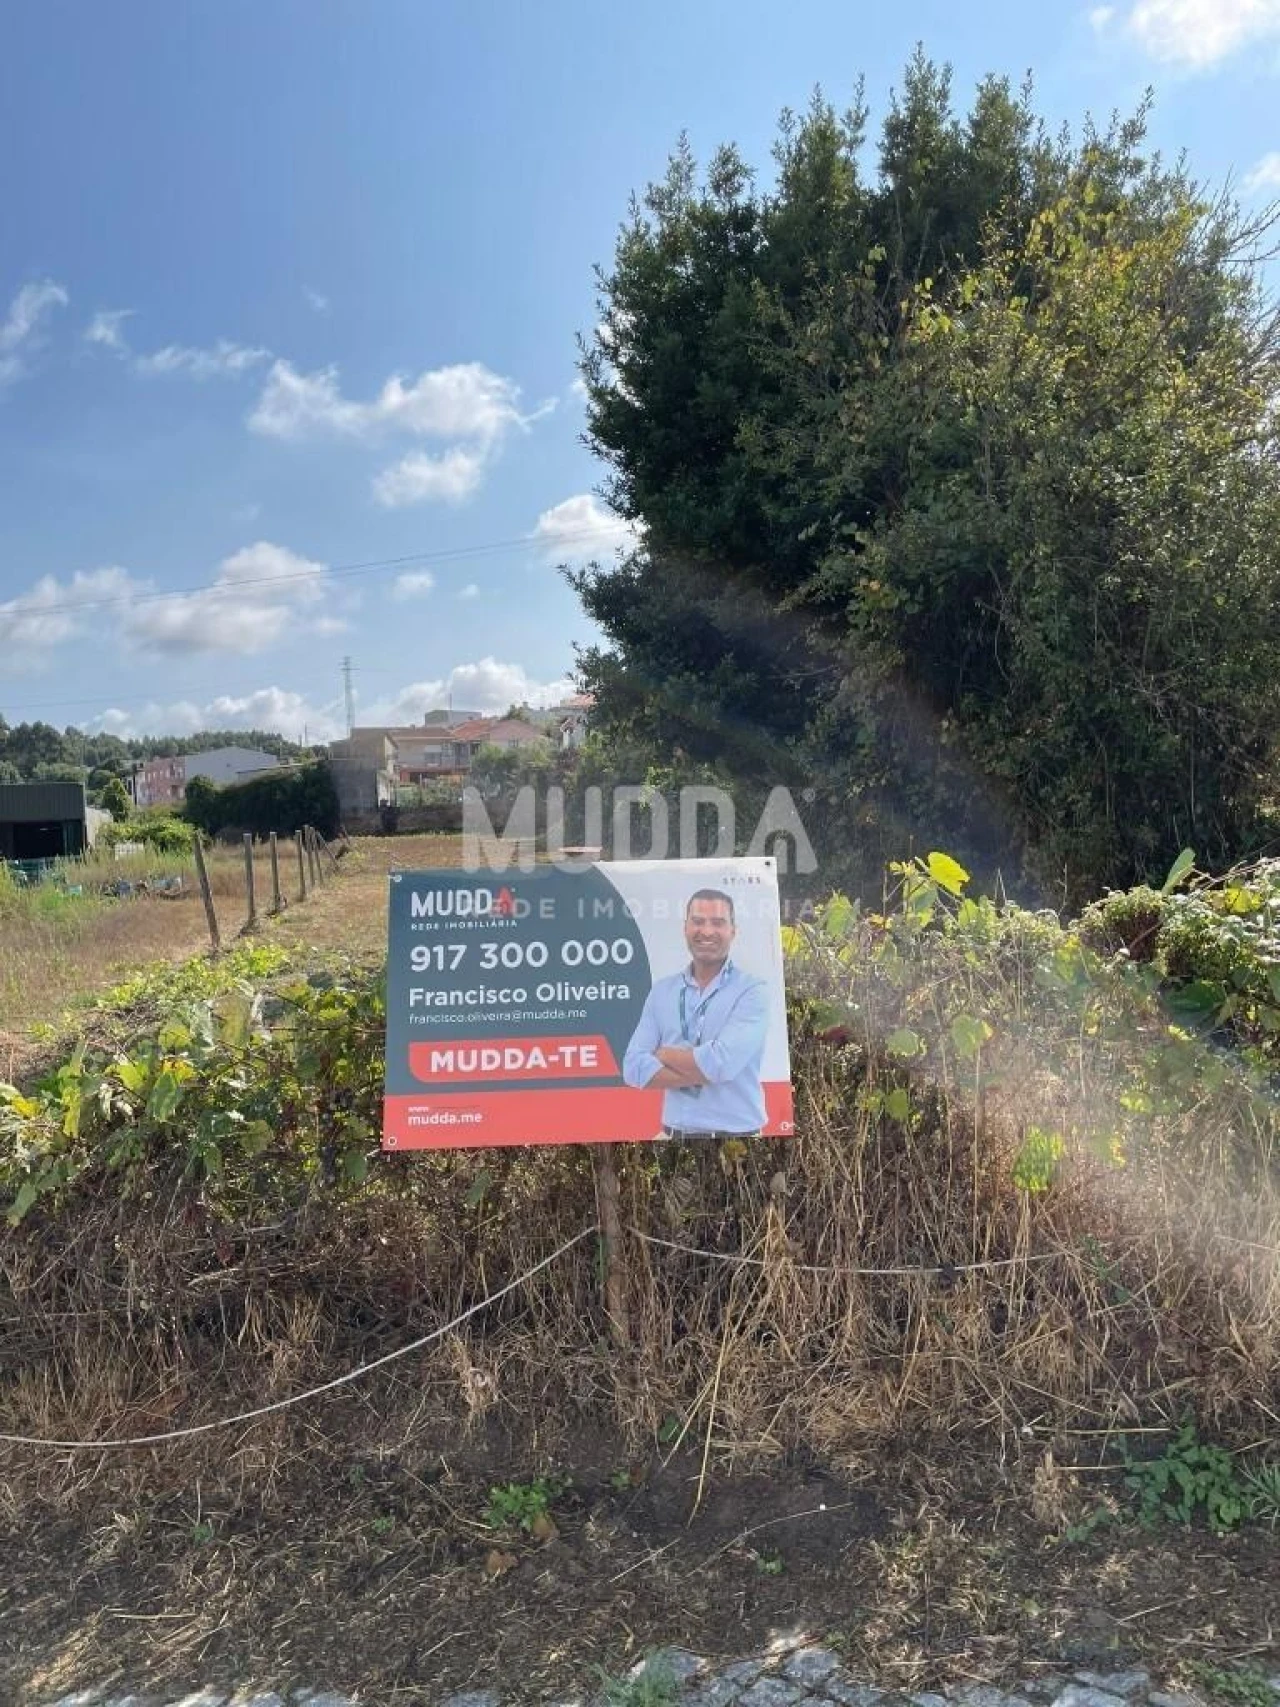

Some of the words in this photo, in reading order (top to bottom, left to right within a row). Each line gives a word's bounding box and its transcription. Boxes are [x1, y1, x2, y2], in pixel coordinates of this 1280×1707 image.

[411, 887, 514, 917] MUDDA
[411, 922, 439, 931] REDE
[410, 944, 467, 971] 917
[479, 941, 548, 969] 300
[560, 938, 633, 966] 000
[409, 986, 527, 1007] Francisco
[536, 981, 631, 1002] Oliveira
[430, 1045, 598, 1073] MUDDA-TE
[408, 1112, 483, 1126] mudda.me
